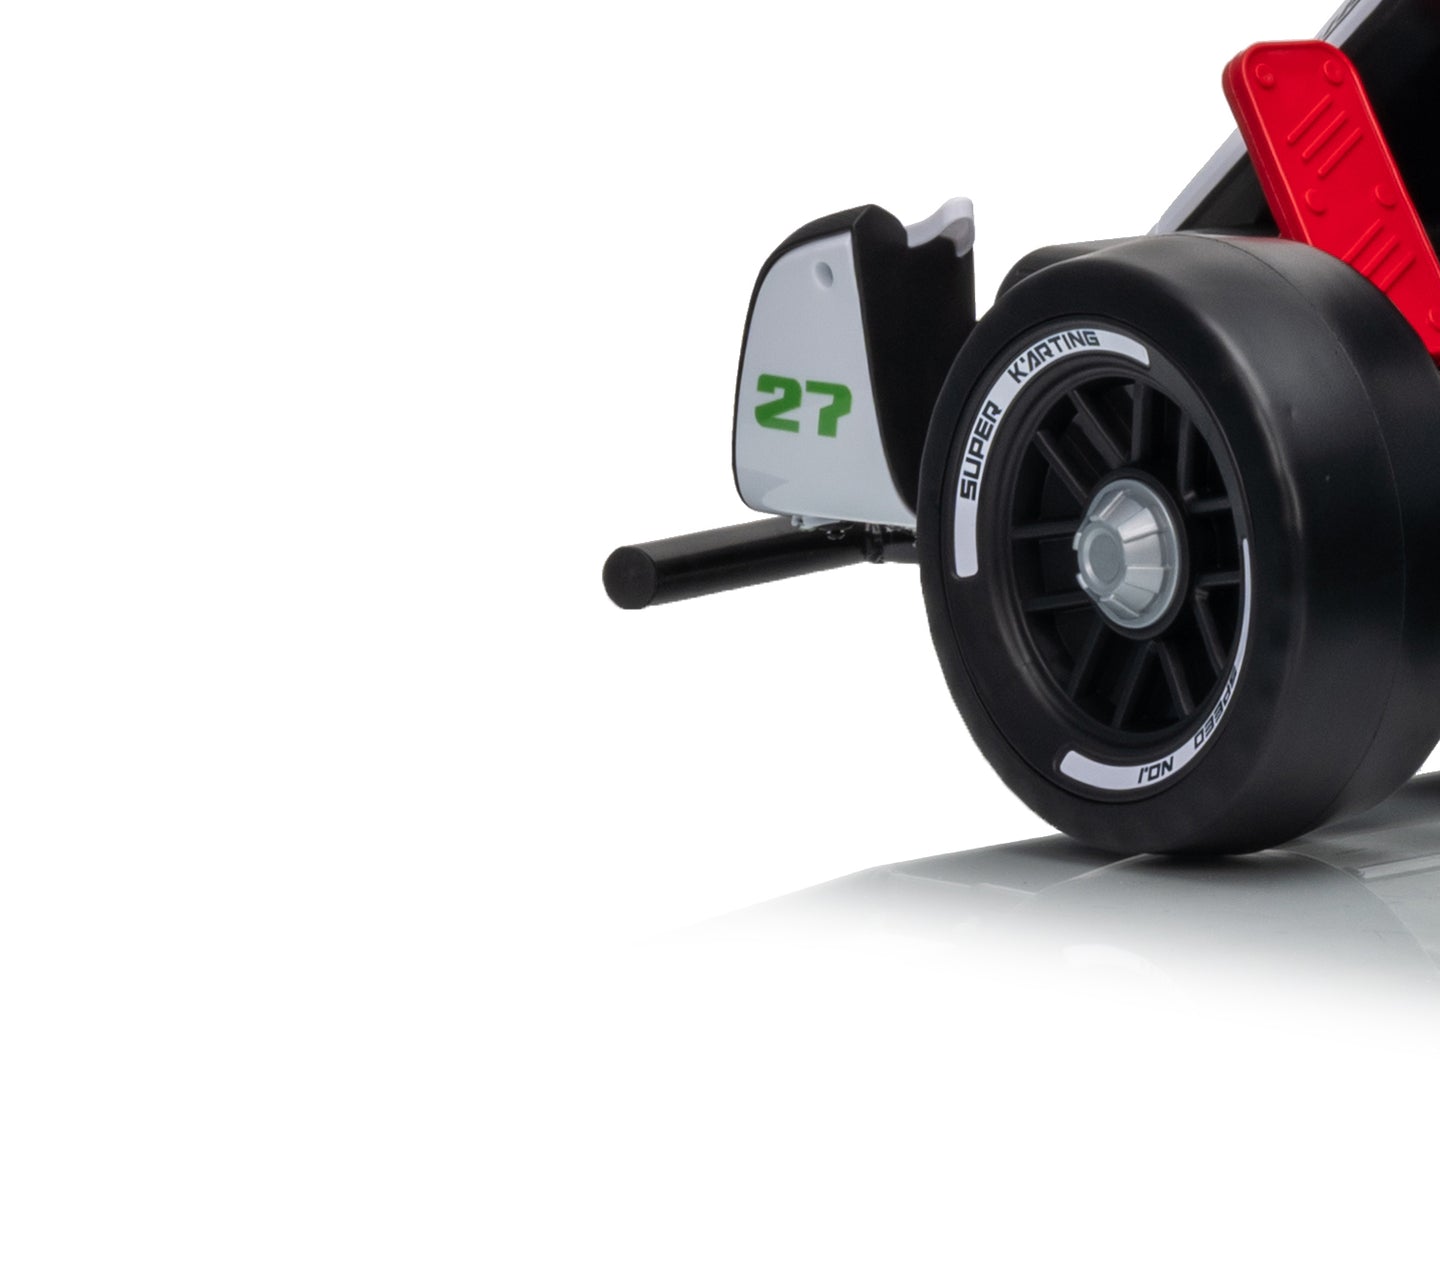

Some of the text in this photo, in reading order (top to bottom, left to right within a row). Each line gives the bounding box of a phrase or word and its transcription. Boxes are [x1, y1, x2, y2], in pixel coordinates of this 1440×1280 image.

[754, 374, 853, 438] 27
[960, 400, 1002, 501] SUPER
[1138, 756, 1174, 784] NO.1
